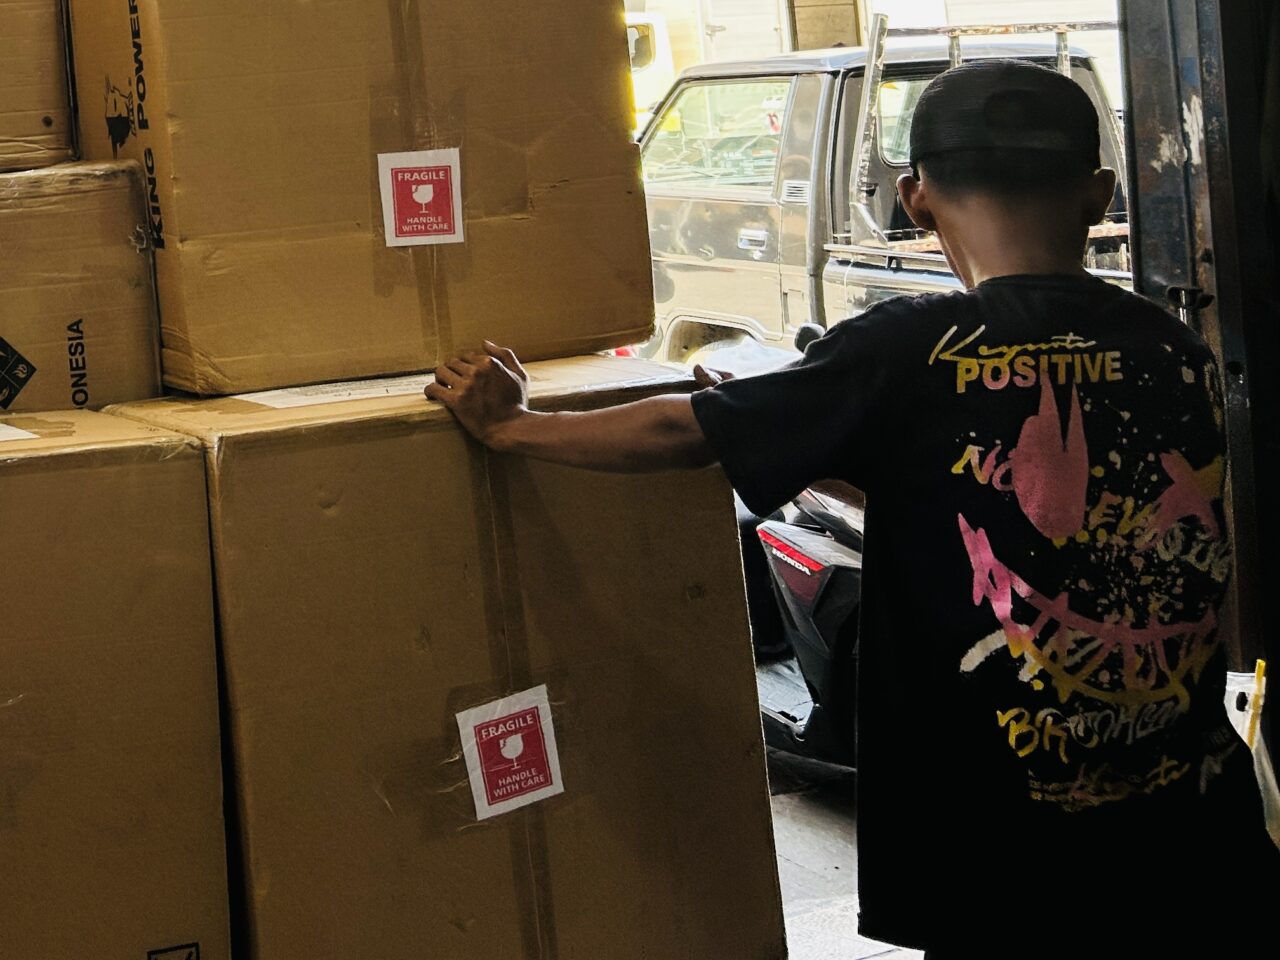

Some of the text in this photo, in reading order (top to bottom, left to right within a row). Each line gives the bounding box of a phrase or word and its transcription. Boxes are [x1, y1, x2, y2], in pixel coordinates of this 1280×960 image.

[397, 171, 446, 182] FRAGILE
[144, 147, 165, 249] KING
[402, 222, 449, 232] WITH CARE
[406, 216, 442, 224] HANDLE
[67, 319, 89, 409] ONESIA
[956, 350, 1124, 394] POSITIVE
[771, 547, 811, 576] HONDA
[481, 713, 534, 739] FRAGILE
[493, 774, 545, 798] WITH CARE
[498, 768, 538, 786] HANDLE
